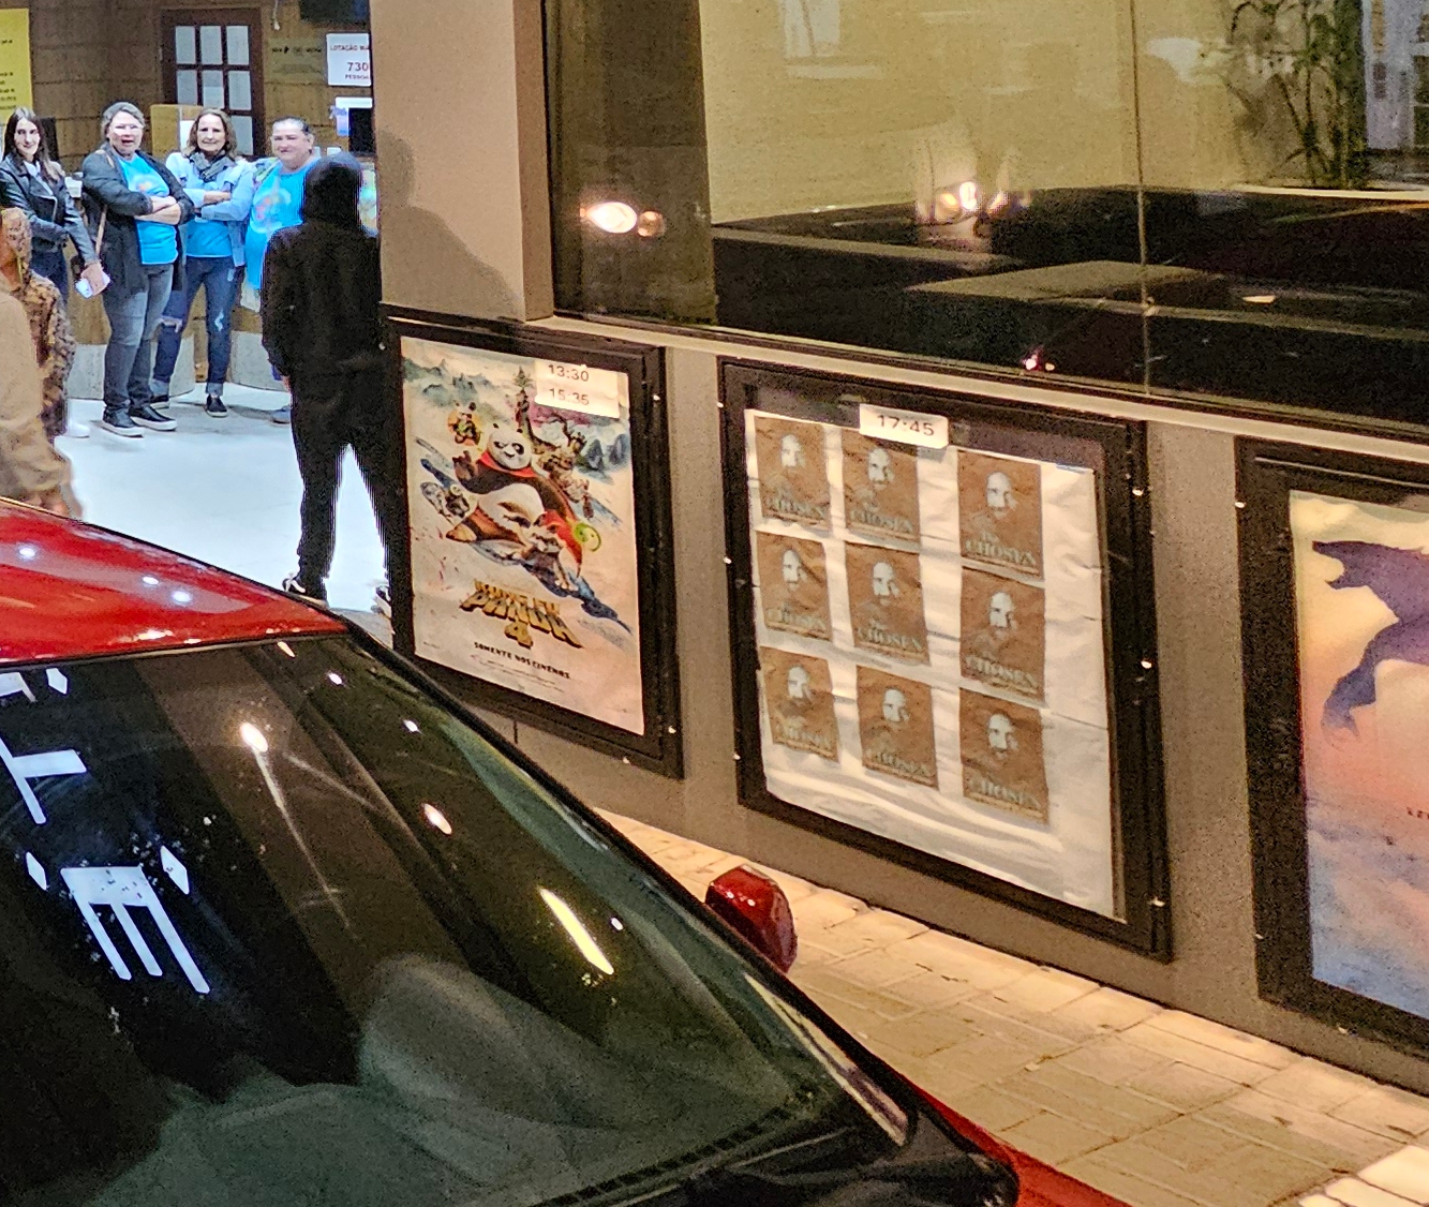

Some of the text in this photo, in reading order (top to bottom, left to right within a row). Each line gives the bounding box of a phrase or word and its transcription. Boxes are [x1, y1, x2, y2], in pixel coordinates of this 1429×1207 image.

[346, 61, 369, 72] 730
[548, 364, 590, 382] 13:30
[876, 413, 936, 437] 17:45
